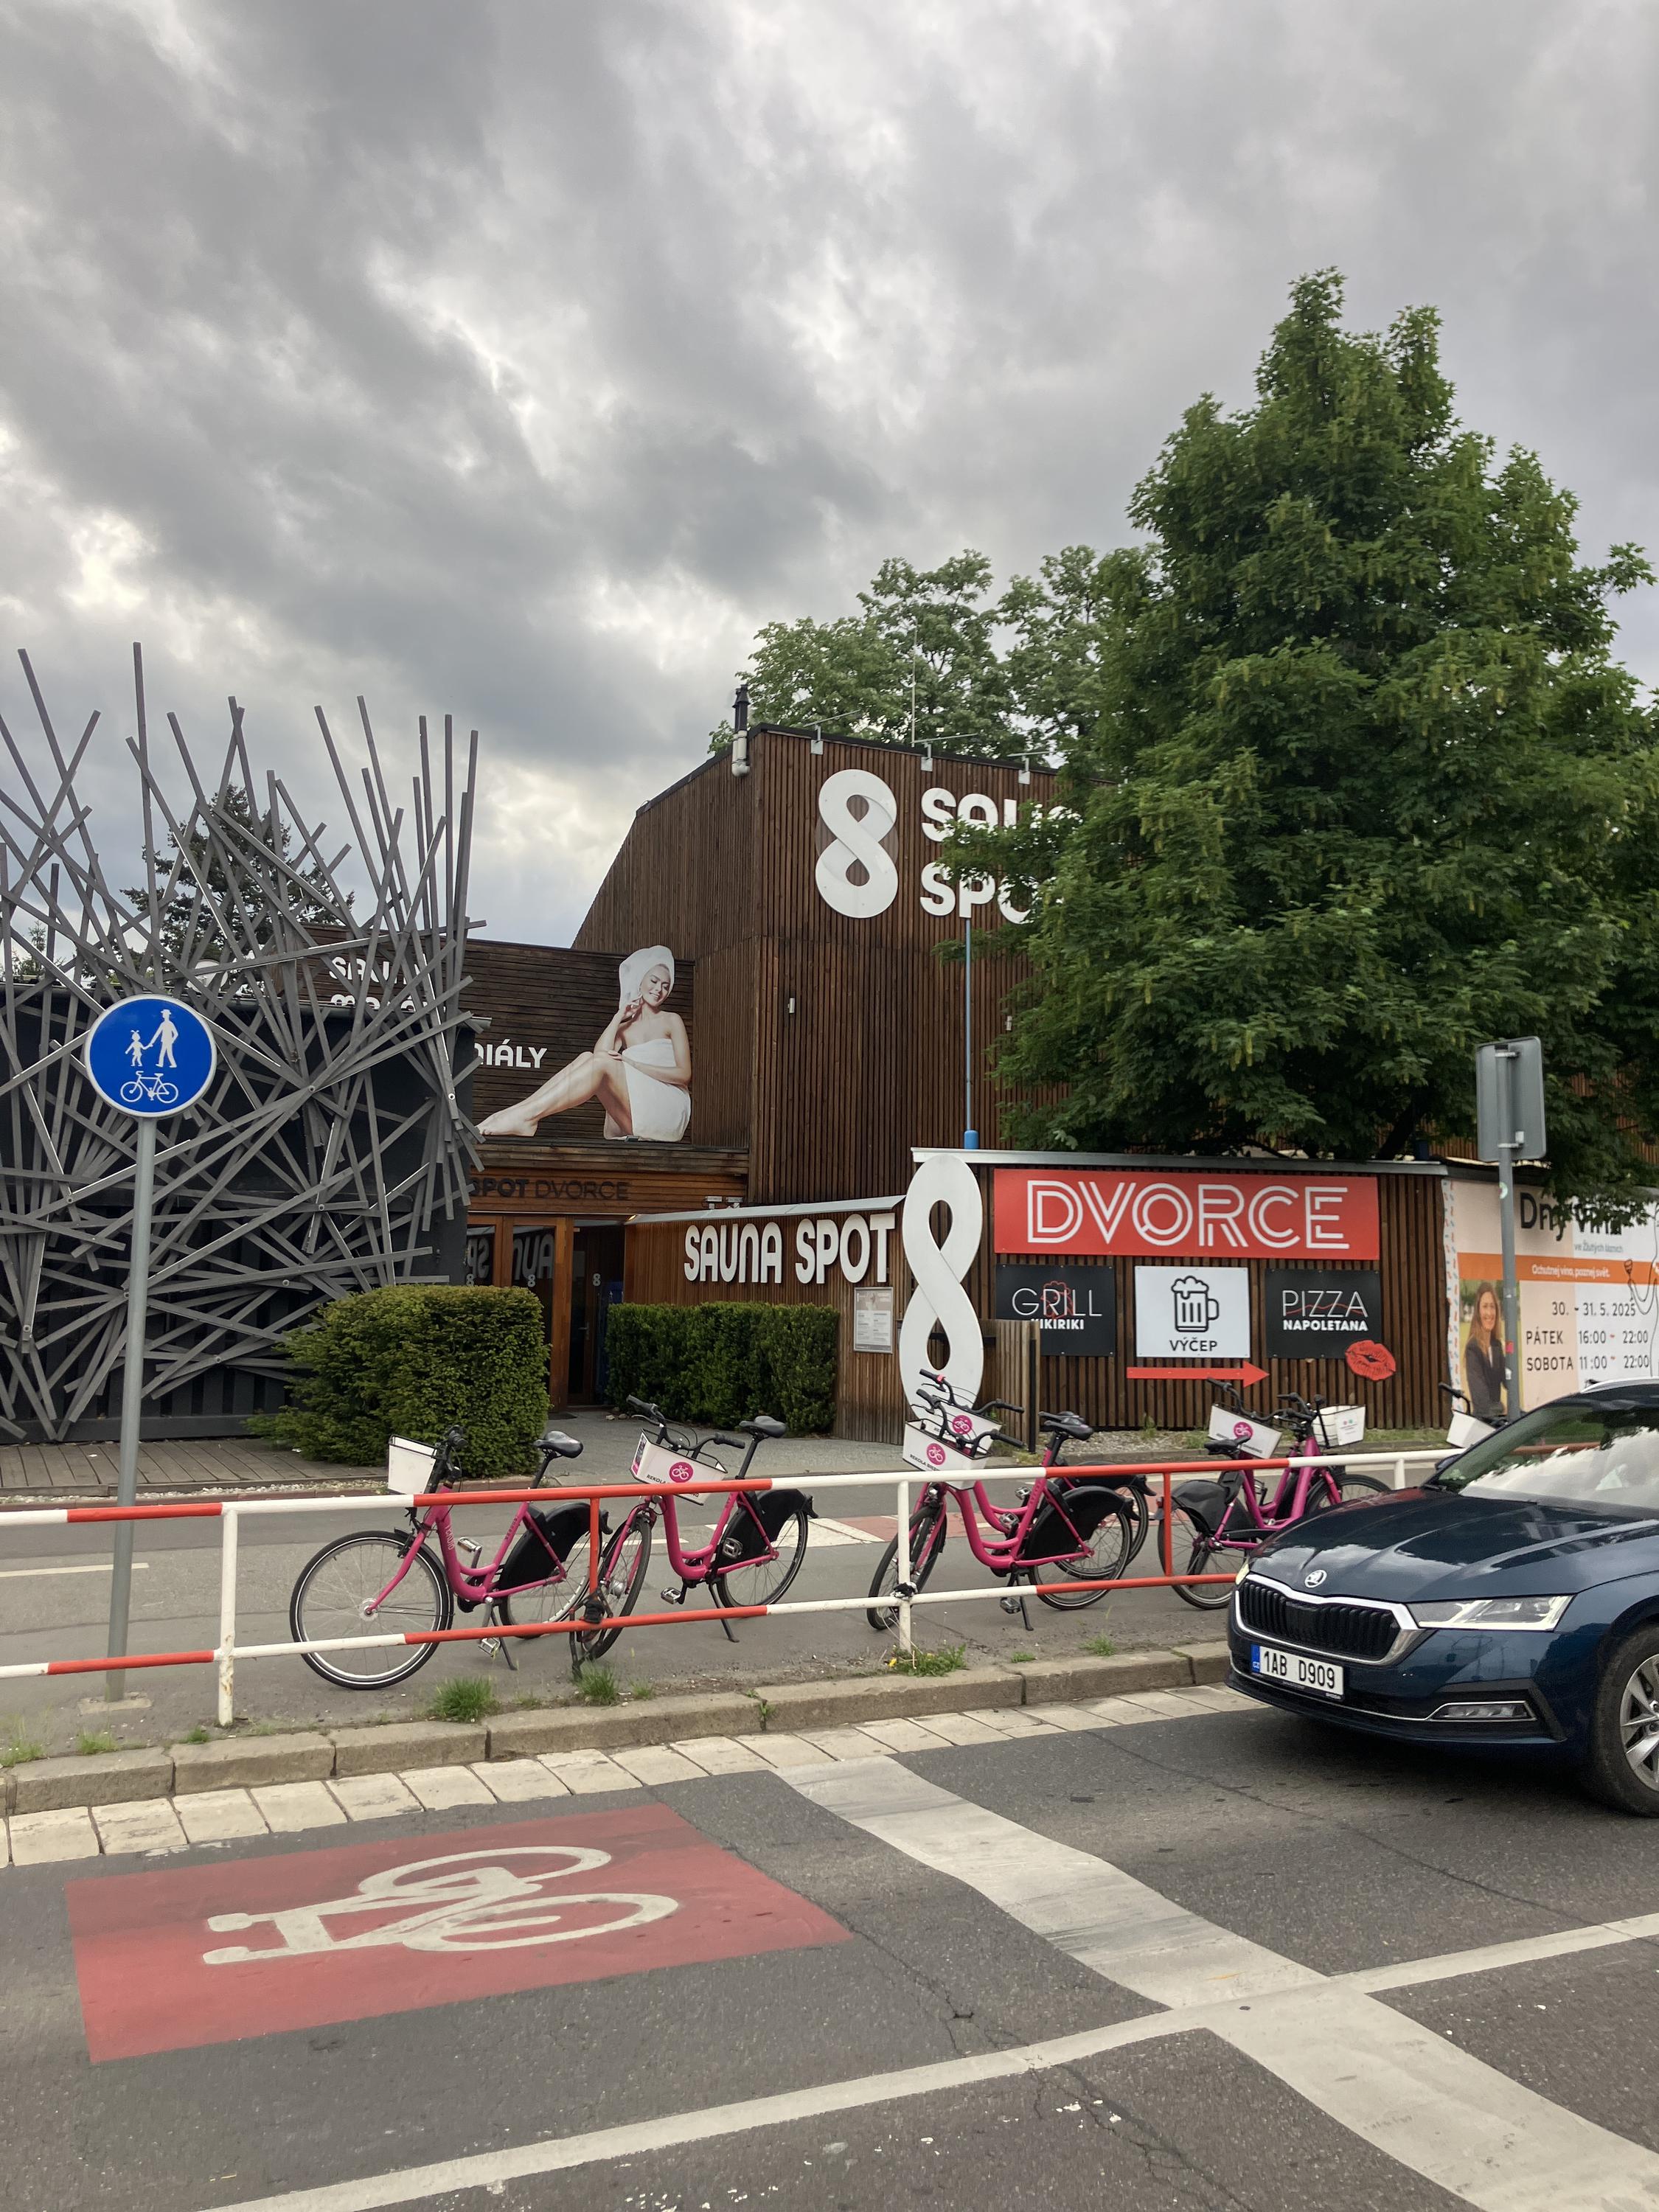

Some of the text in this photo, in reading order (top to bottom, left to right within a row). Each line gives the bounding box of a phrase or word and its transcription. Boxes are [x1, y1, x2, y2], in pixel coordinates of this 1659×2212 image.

[919, 861, 1064, 925] SPO
[535, 1180, 630, 1200] DVORCE
[1027, 1180, 1350, 1249] DVORCE
[684, 1212, 895, 1284] SAUNA SPOT
[1012, 1287, 1102, 1316] GRILL
[1282, 1290, 1368, 1318] PIZZA
[1552, 1301, 1569, 1316] 30.
[1613, 1303, 1636, 1317] 2025
[1283, 1319, 1368, 1331] NAPOLETANA
[1526, 1326, 1563, 1345] PÁTEK
[1579, 1330, 1607, 1344] 16:00
[1623, 1330, 1649, 1344] 22:00
[1169, 1337, 1217, 1352] VÝČEP
[1526, 1357, 1574, 1371] SOBOTA
[1624, 1354, 1649, 1368] 22:00
[1264, 1651, 1335, 1689] 1AB D909
